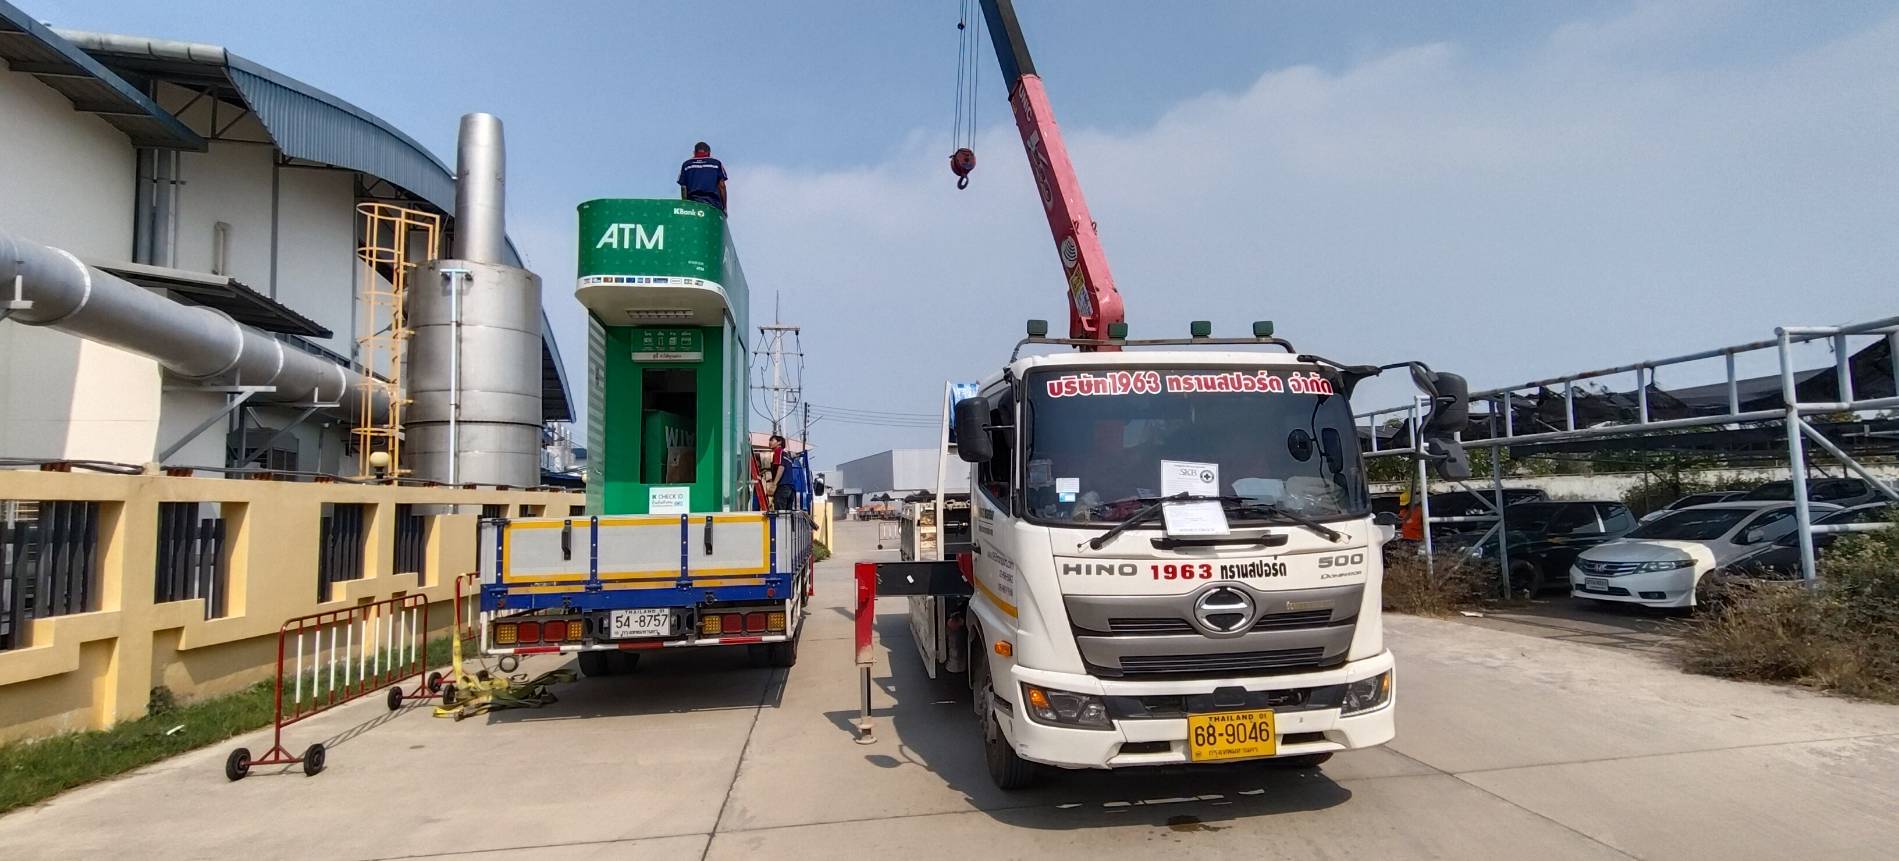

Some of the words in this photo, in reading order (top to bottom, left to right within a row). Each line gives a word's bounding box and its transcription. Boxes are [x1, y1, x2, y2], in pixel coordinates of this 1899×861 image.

[673, 207, 697, 216] KBank
[596, 223, 664, 250] ATM
[1288, 371, 1334, 396] จำกัด
[1318, 553, 1363, 568] 500
[1063, 563, 1137, 576] HINO
[1151, 564, 1212, 580] 1963
[1208, 714, 1254, 722] THAILAND
[1195, 721, 1270, 747] 68-9046
